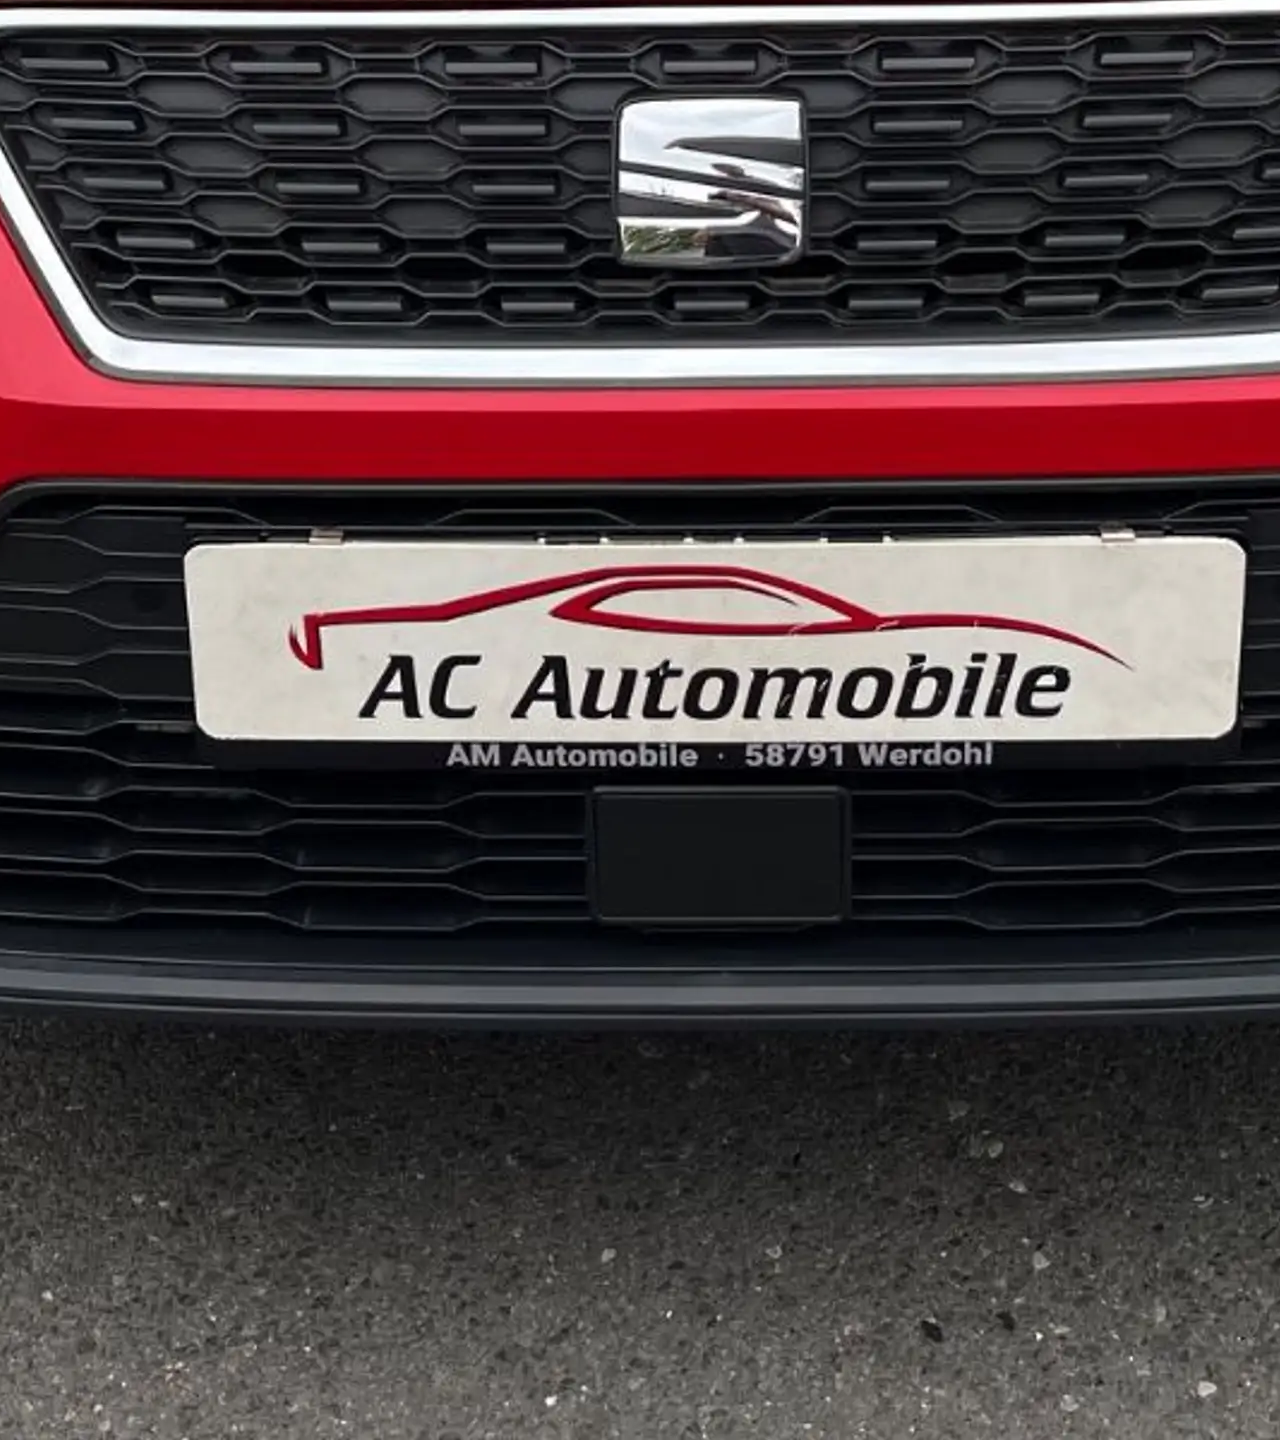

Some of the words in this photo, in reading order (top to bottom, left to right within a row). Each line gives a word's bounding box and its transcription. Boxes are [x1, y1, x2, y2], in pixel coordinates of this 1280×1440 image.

[358, 654, 482, 719] AC
[510, 652, 1071, 720] Automobile
[446, 743, 501, 767] AM
[511, 741, 699, 767] Automobile
[744, 743, 843, 766] 58791
[858, 740, 993, 766] Werdohl
